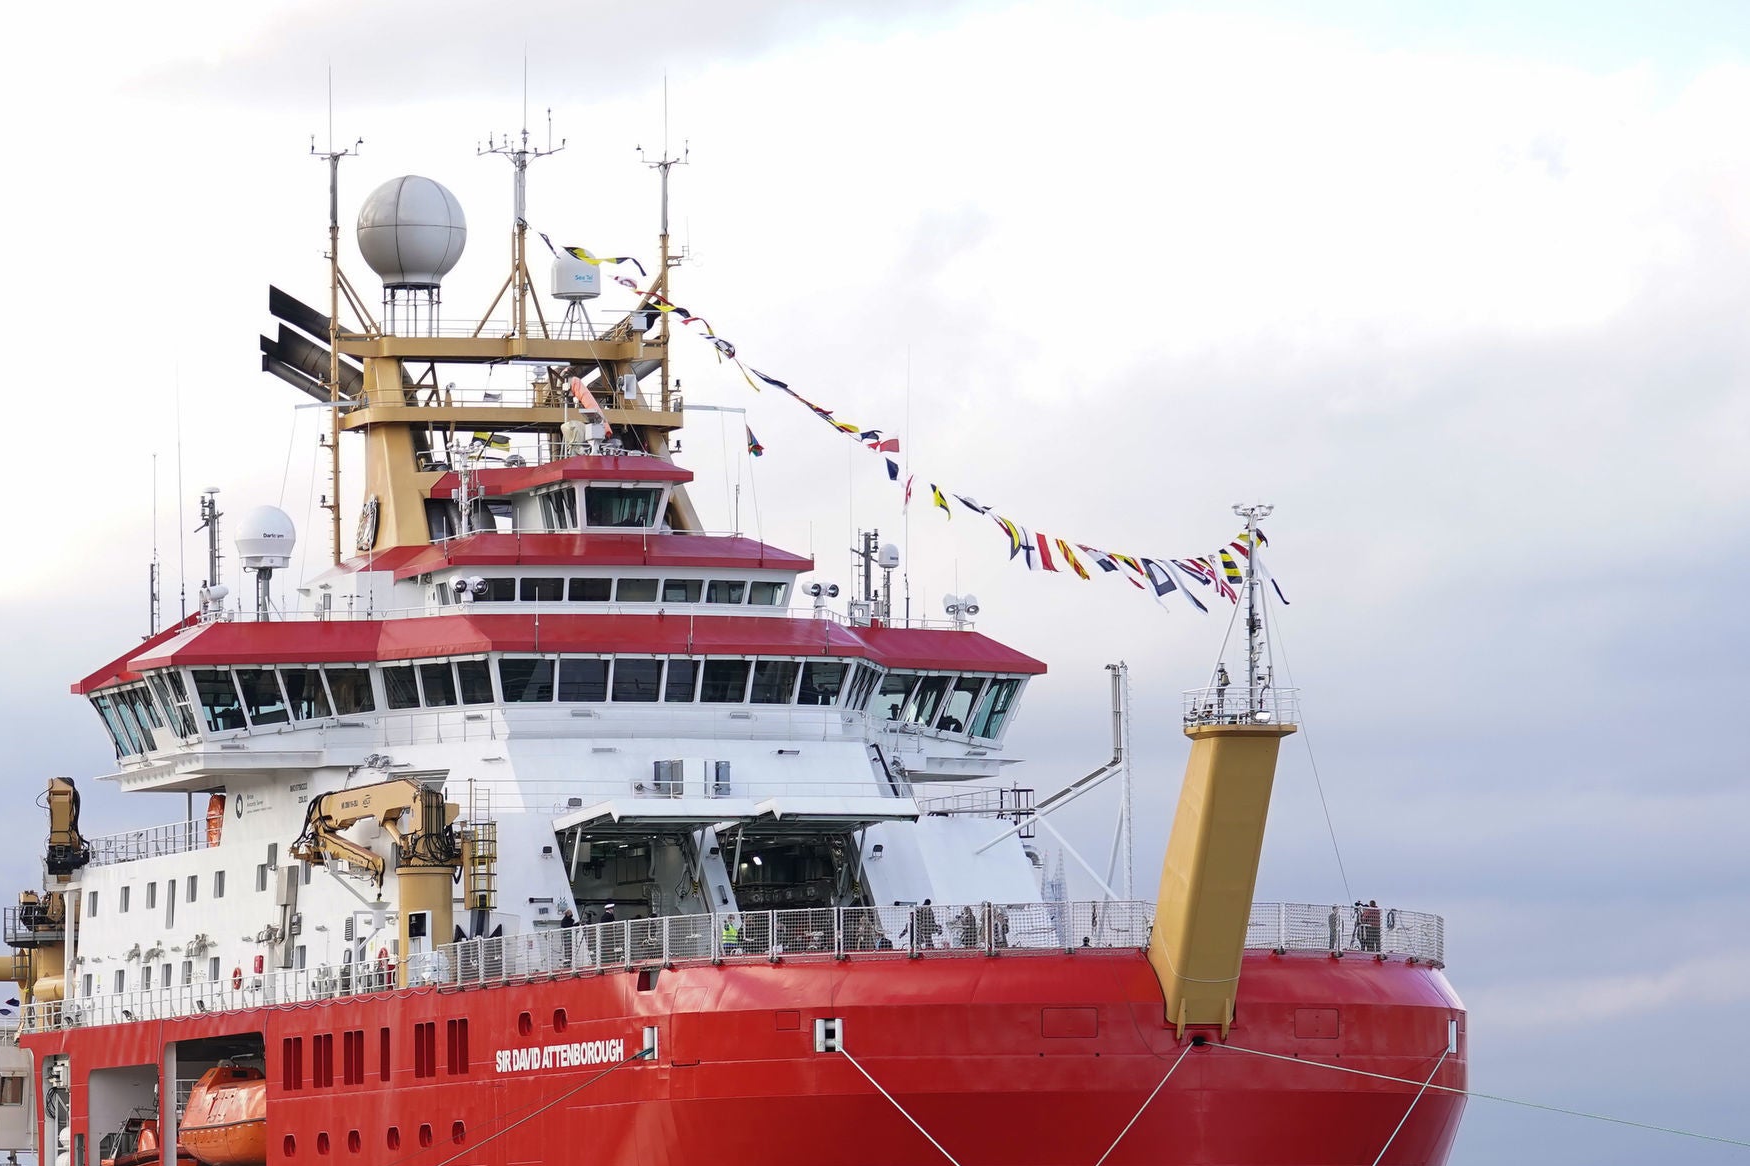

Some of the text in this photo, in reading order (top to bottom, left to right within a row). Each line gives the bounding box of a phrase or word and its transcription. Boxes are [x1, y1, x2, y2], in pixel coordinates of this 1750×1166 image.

[496, 1038, 624, 1073] SIR DAVID ATTENBOROUGH
